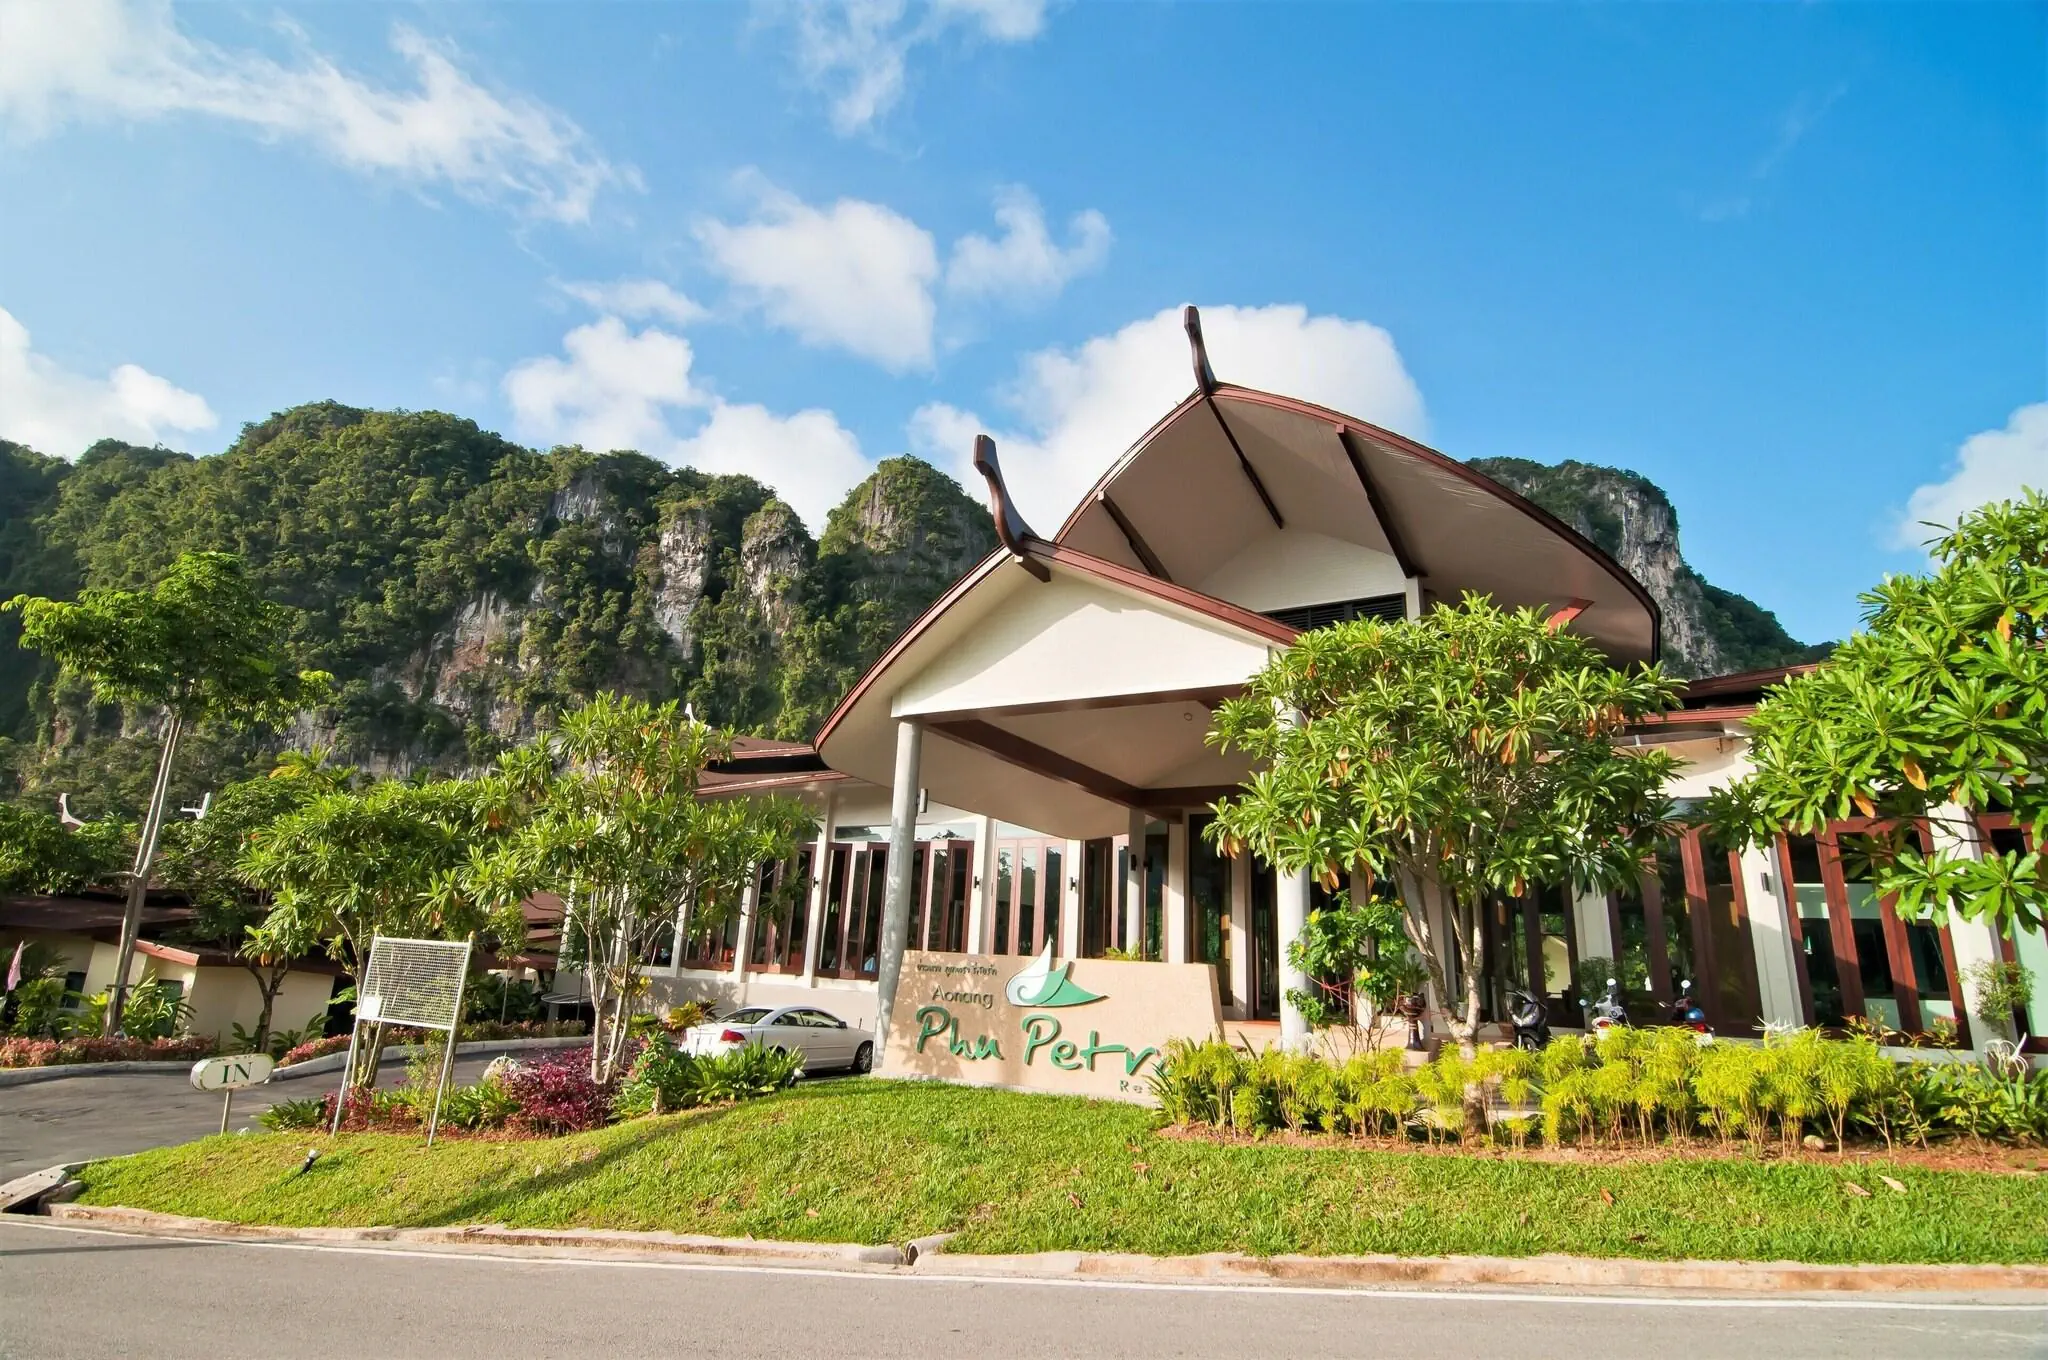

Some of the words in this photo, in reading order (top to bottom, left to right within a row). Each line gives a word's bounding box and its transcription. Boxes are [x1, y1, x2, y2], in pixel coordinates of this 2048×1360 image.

[932, 985, 994, 1010] Aonang
[915, 1006, 1004, 1060] Phu
[221, 1061, 253, 1084] IN
